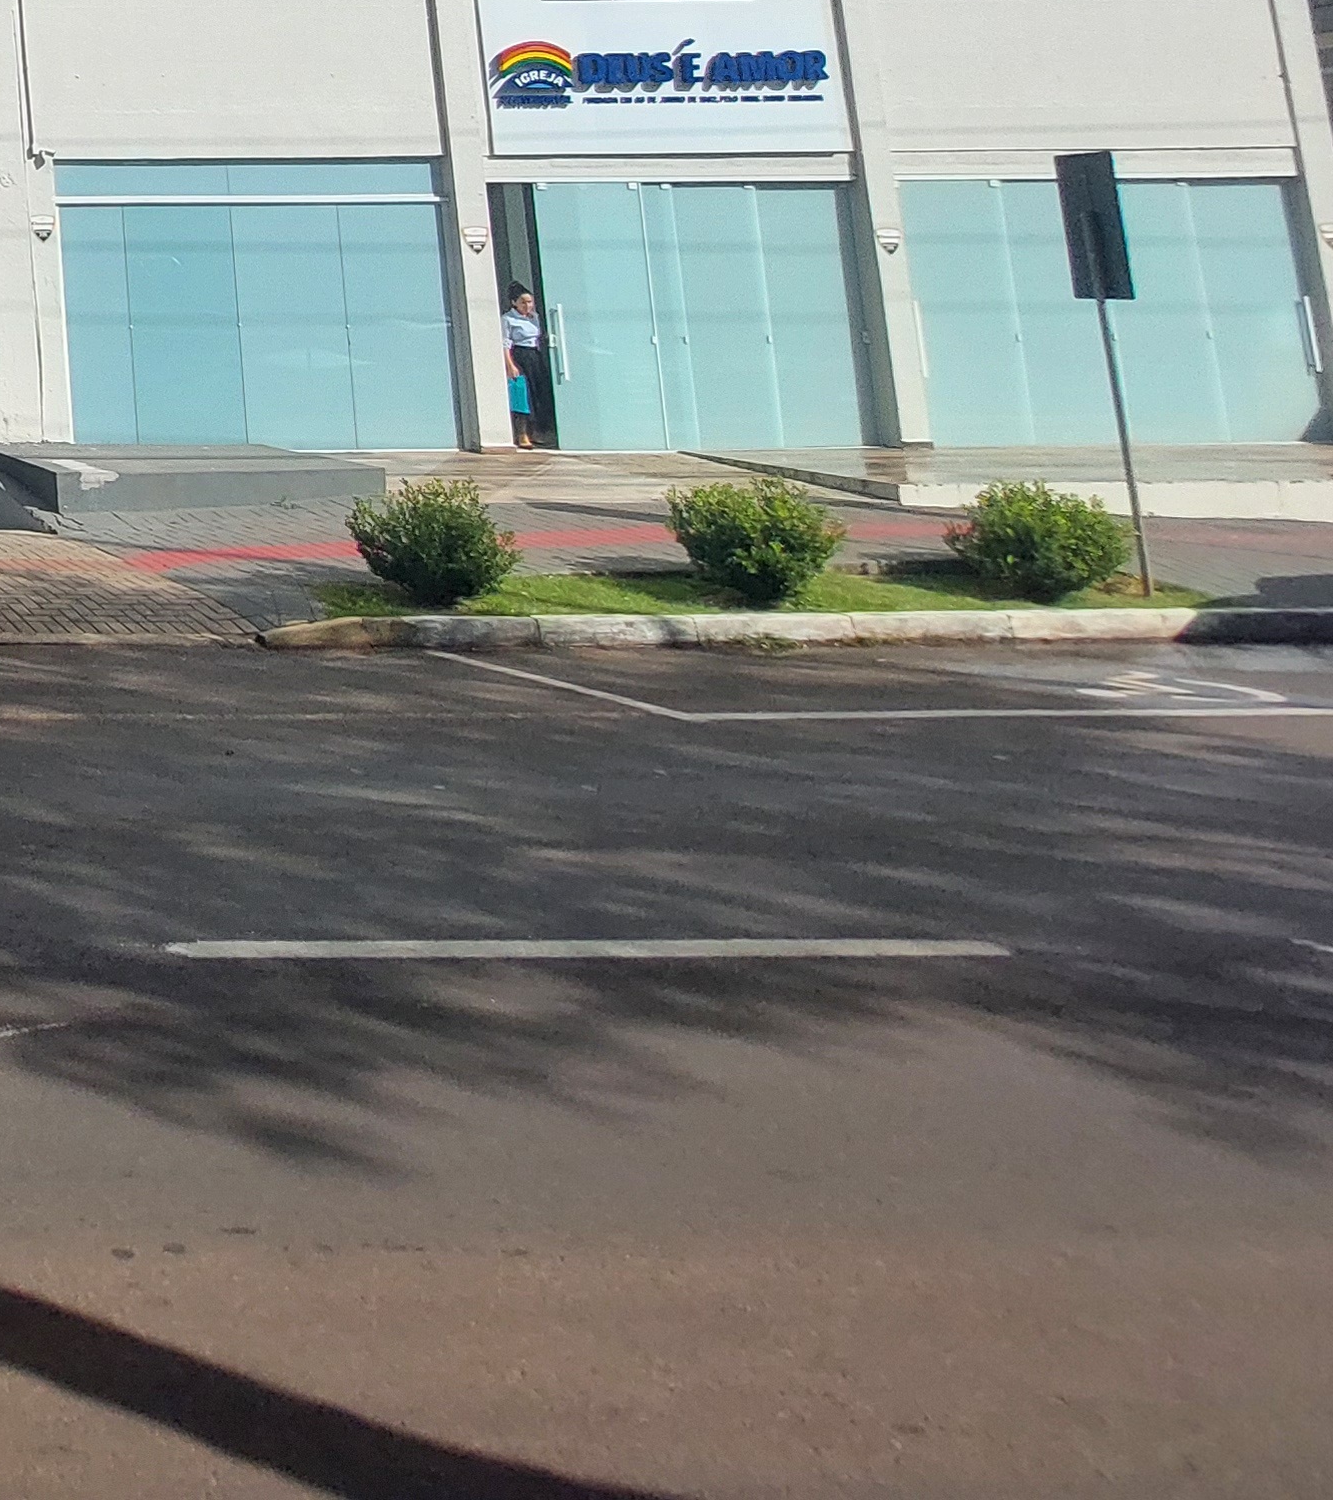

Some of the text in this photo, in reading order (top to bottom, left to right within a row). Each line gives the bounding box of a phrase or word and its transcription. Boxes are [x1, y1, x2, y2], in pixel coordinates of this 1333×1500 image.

[513, 69, 565, 88] IGREJA
[577, 52, 674, 85] DEUS
[707, 50, 830, 84] AMOR
